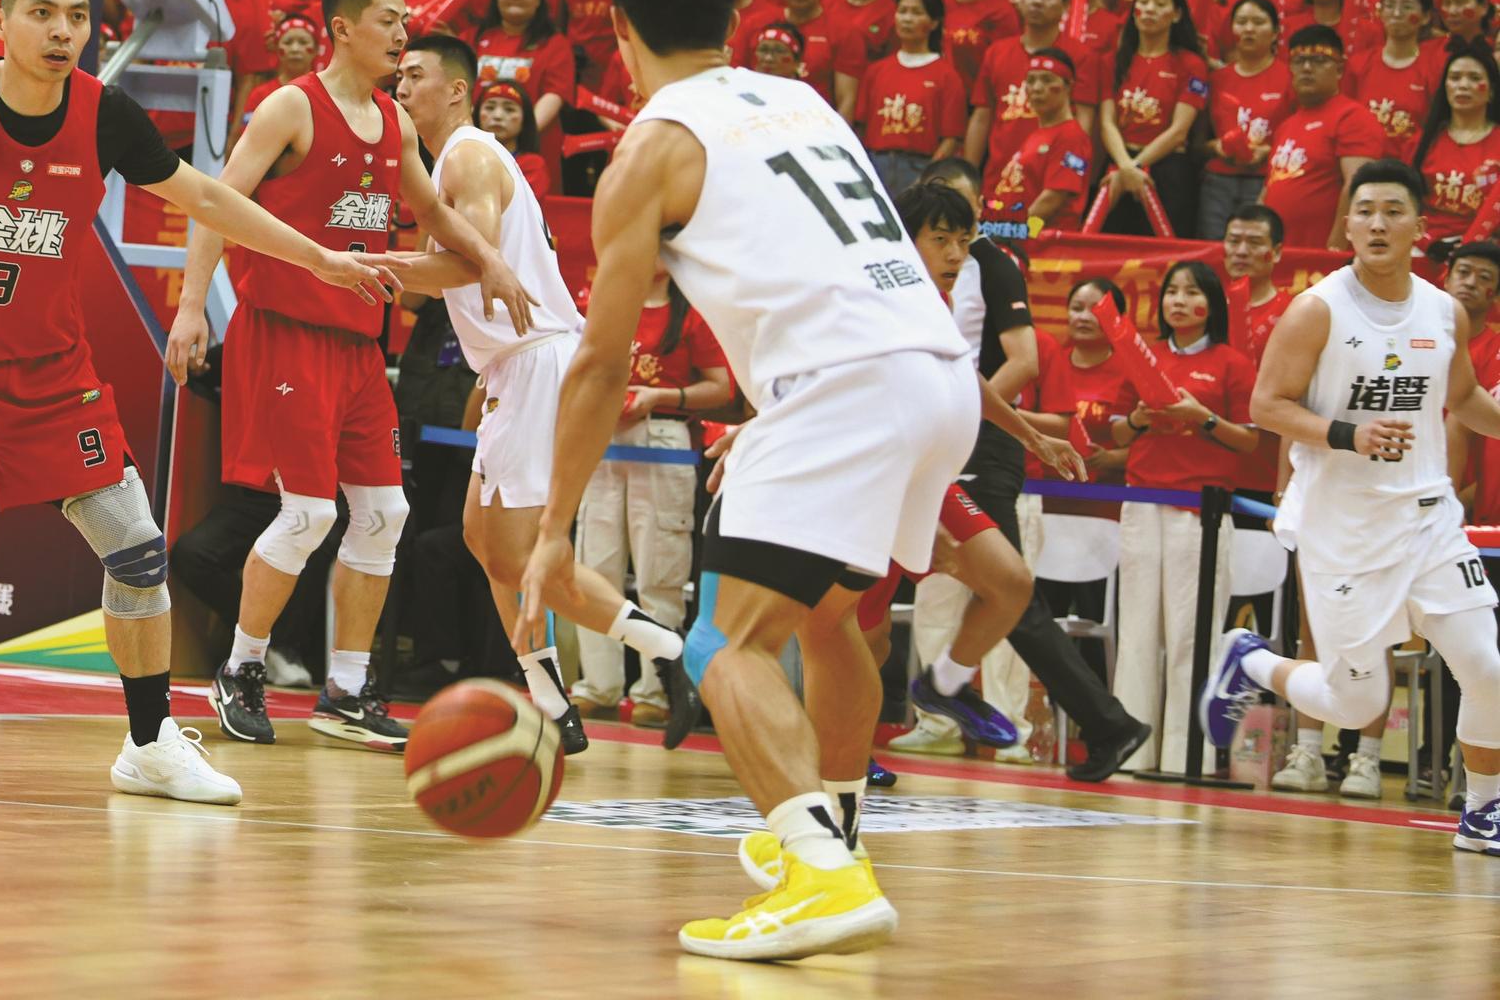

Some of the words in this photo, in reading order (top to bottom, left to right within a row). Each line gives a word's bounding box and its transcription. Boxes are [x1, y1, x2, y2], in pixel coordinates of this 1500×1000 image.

[324, 190, 392, 233] 余姚
[764, 144, 903, 246] 13
[1347, 374, 1431, 412] 诸暨
[76, 427, 107, 468] 9
[1456, 558, 1487, 589] 10
